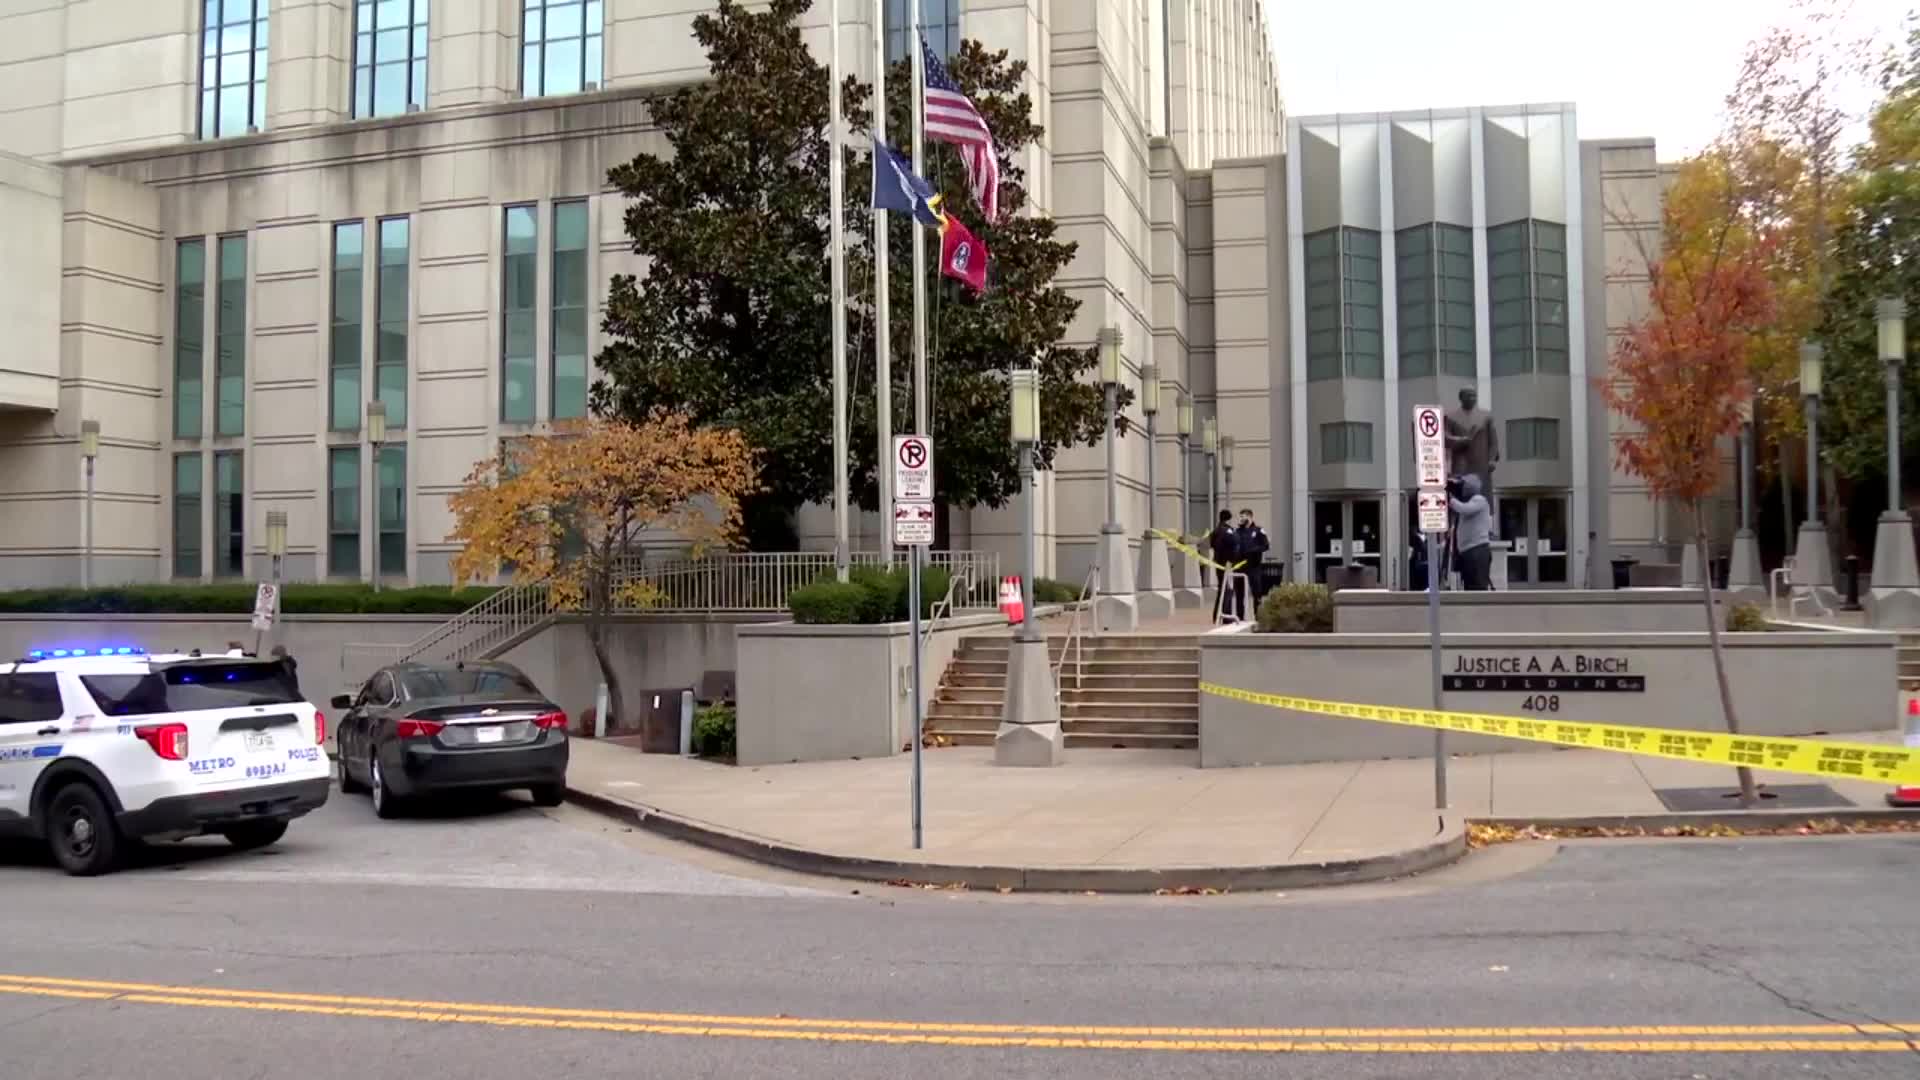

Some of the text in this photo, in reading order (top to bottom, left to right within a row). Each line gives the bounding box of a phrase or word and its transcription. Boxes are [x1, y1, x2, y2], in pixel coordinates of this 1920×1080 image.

[1454, 655, 1520, 673] JUSTICE
[1551, 655, 1570, 673] A.
[1575, 655, 1628, 673] BIRCH
[1521, 695, 1560, 712] 408
[287, 747, 319, 759] POLICE
[189, 757, 236, 772] METRO
